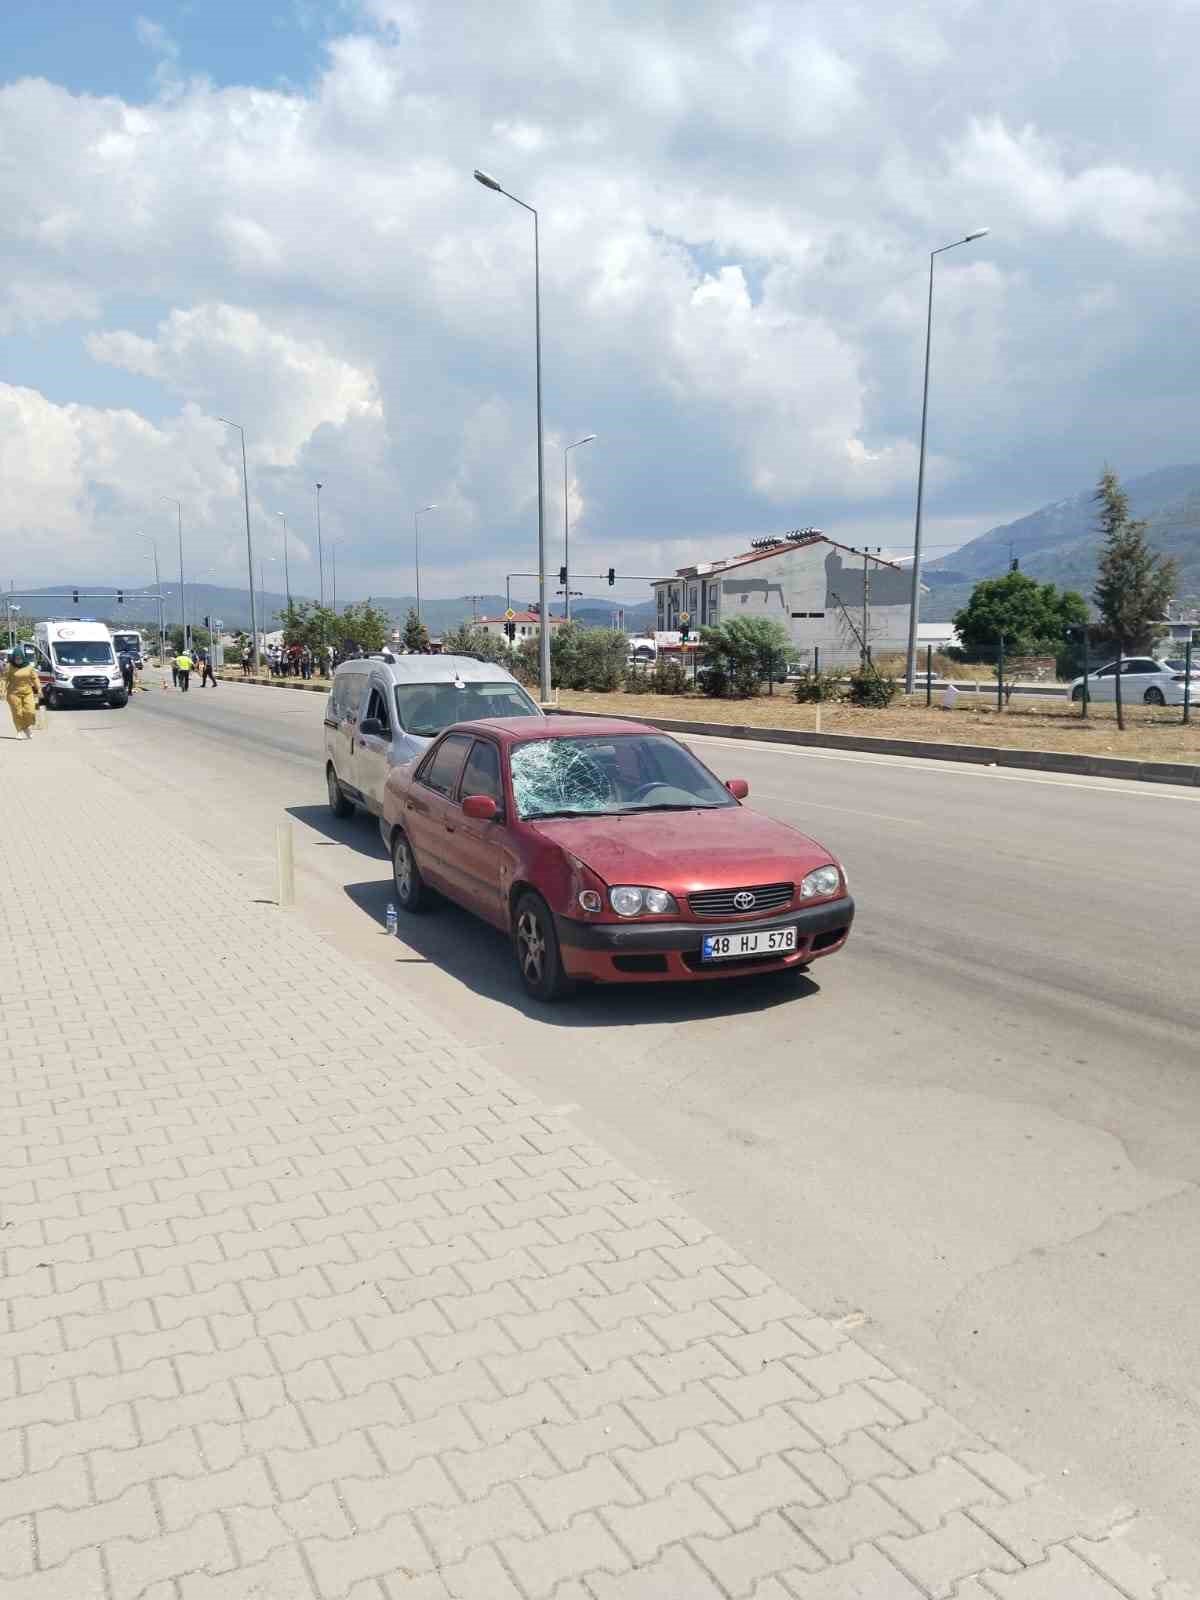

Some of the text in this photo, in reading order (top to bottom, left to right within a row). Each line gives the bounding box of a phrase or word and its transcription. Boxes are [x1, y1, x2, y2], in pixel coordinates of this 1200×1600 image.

[712, 931, 794, 954] 48 HJ 578
